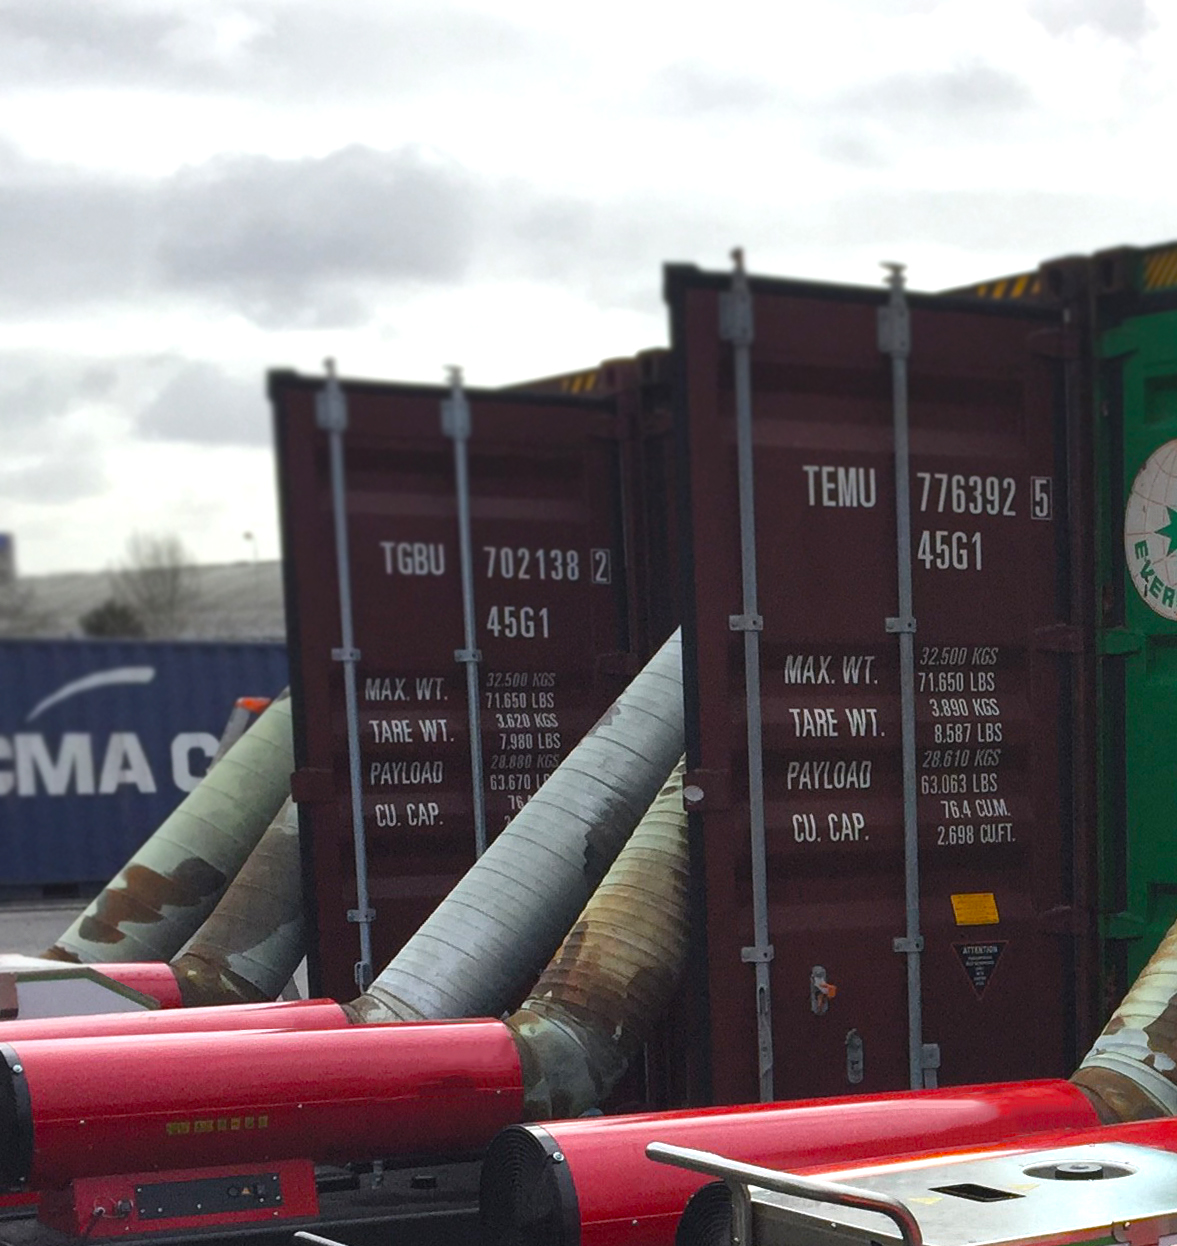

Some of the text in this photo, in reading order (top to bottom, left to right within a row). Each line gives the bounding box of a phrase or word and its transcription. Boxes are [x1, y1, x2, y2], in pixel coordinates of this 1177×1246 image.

[803, 465, 1048, 517] TEMU 776392 5
[380, 541, 608, 582] TGBU 702138 2
[917, 530, 982, 571] 45G1
[486, 606, 549, 638] 45G1
[971, 646, 999, 665] KGS
[532, 672, 556, 687] KGS
[784, 654, 878, 684] MAX. WT.
[365, 678, 448, 701] MAX. WT.
[970, 671, 995, 692] LBS
[532, 692, 555, 709] LBS
[973, 698, 1000, 716] KGS
[368, 719, 455, 743] TARE WT.
[533, 713, 559, 728] KGS
[789, 708, 885, 737] TARE WT.
[538, 732, 562, 749] LBS
[978, 722, 1003, 742] LBS
[536, 754, 560, 768] KGS
[974, 748, 1001, 767] KGS
[370, 761, 443, 785] PAYLOAD
[787, 761, 872, 790] PAYLOAD
[972, 773, 998, 793] LBS
[375, 802, 444, 827] CU. CAP.
[940, 800, 972, 819] 76.4
[792, 812, 869, 843] CU. CAP.
